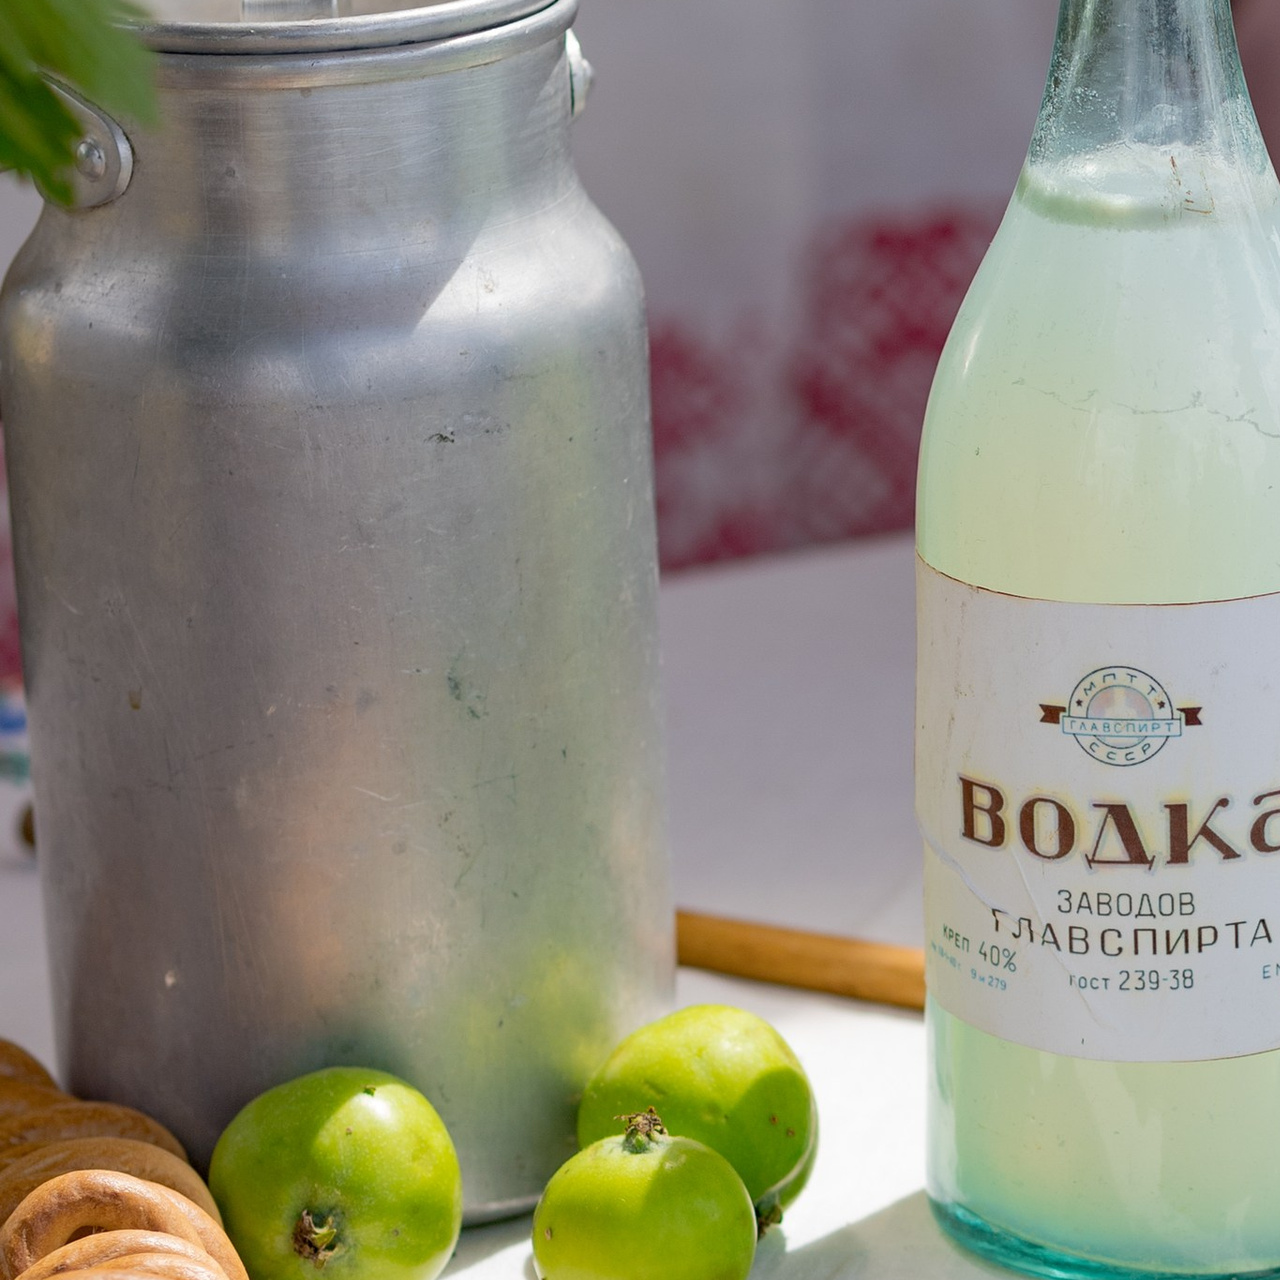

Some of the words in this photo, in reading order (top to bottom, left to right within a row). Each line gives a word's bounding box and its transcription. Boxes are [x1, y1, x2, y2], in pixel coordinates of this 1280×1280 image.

[1069, 720, 1174, 734] ГЛАВСПИРТ
[1089, 741, 1151, 762] СССР
[1056, 889, 1196, 919] ЗАВОДОВ
[991, 908, 1273, 957] ГЛАВСПИРТА
[978, 940, 1017, 972] 40%
[987, 974, 1008, 992] 279
[1118, 968, 1195, 991] 239-38
